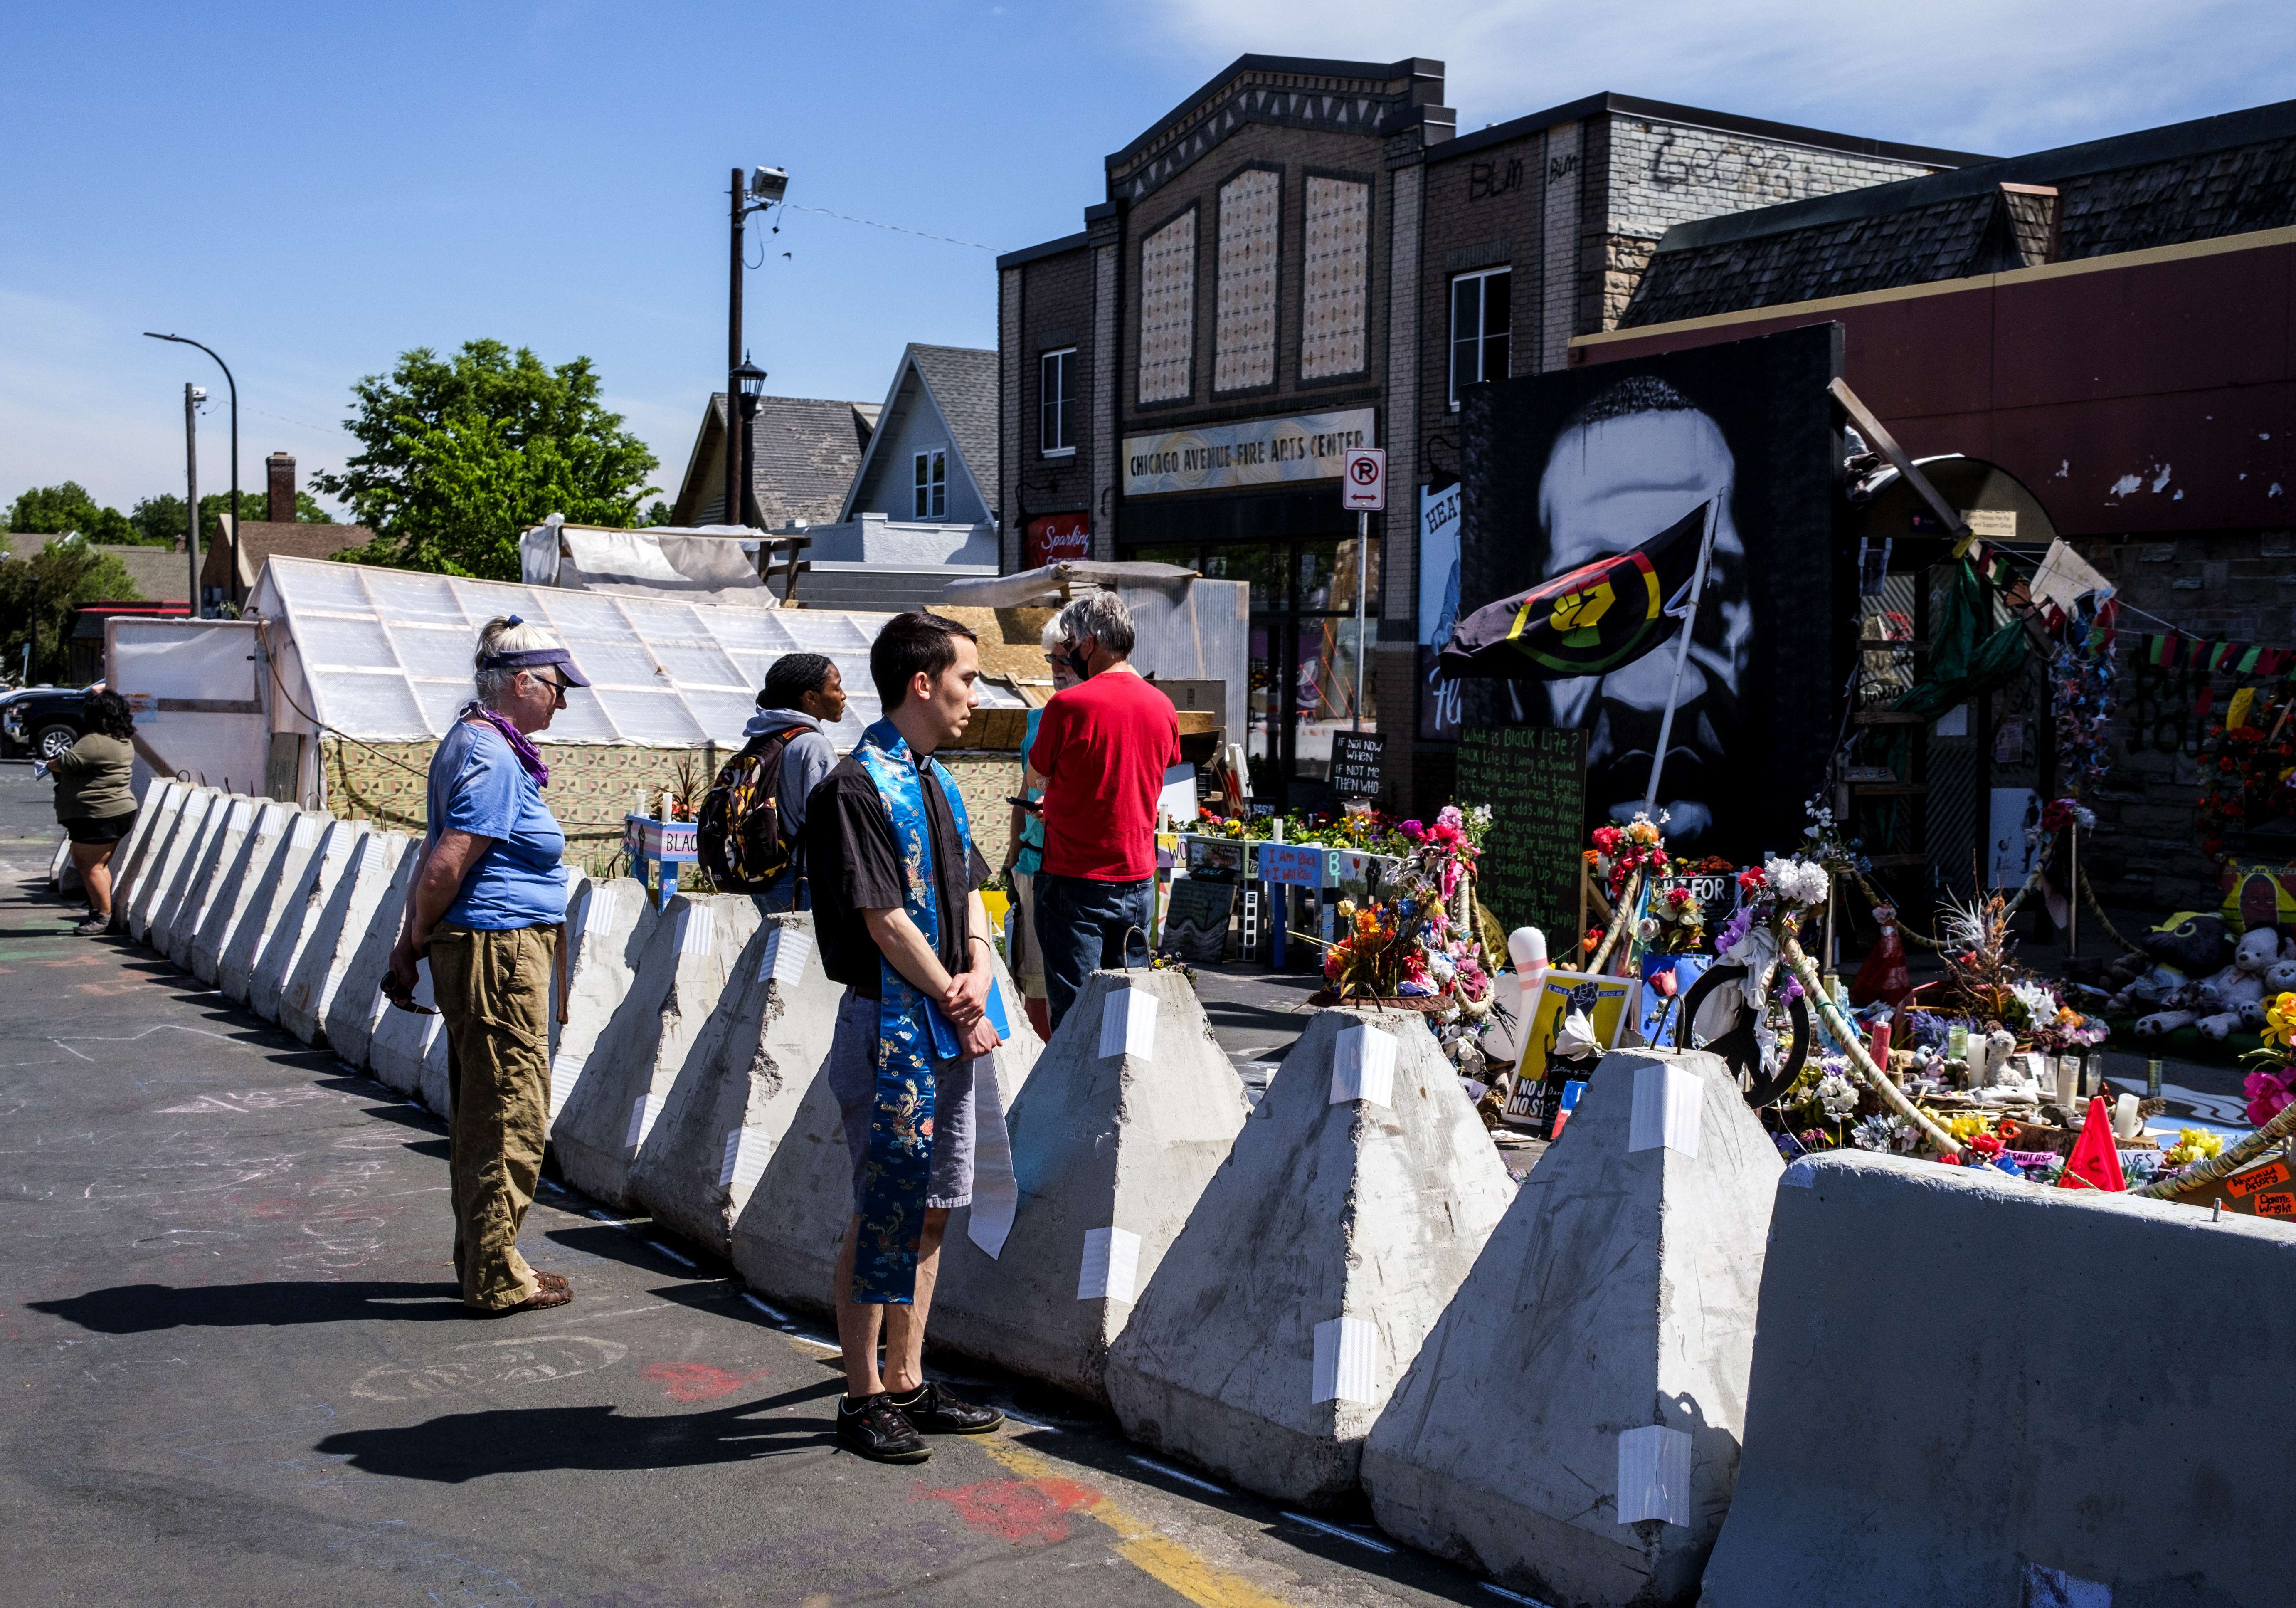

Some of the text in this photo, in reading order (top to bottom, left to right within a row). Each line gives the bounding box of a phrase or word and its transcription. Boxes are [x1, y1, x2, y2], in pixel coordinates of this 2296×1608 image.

[1470, 159, 1523, 202] BLM
[1130, 430, 1364, 477] CHICAGO AVENUE FIRE ARTS CENTER
[1338, 737, 1383, 752] IF NOT NOW
[1491, 731, 1499, 746] is
[1336, 764, 1343, 774] IF
[1346, 765, 1364, 776] NOT
[1532, 772, 1548, 787] the
[1518, 1079, 1536, 1096] NO
[1509, 1096, 1529, 1114] NO
[2012, 1153, 2035, 1162] SHOT
[2259, 1203, 2292, 1214] Wright
